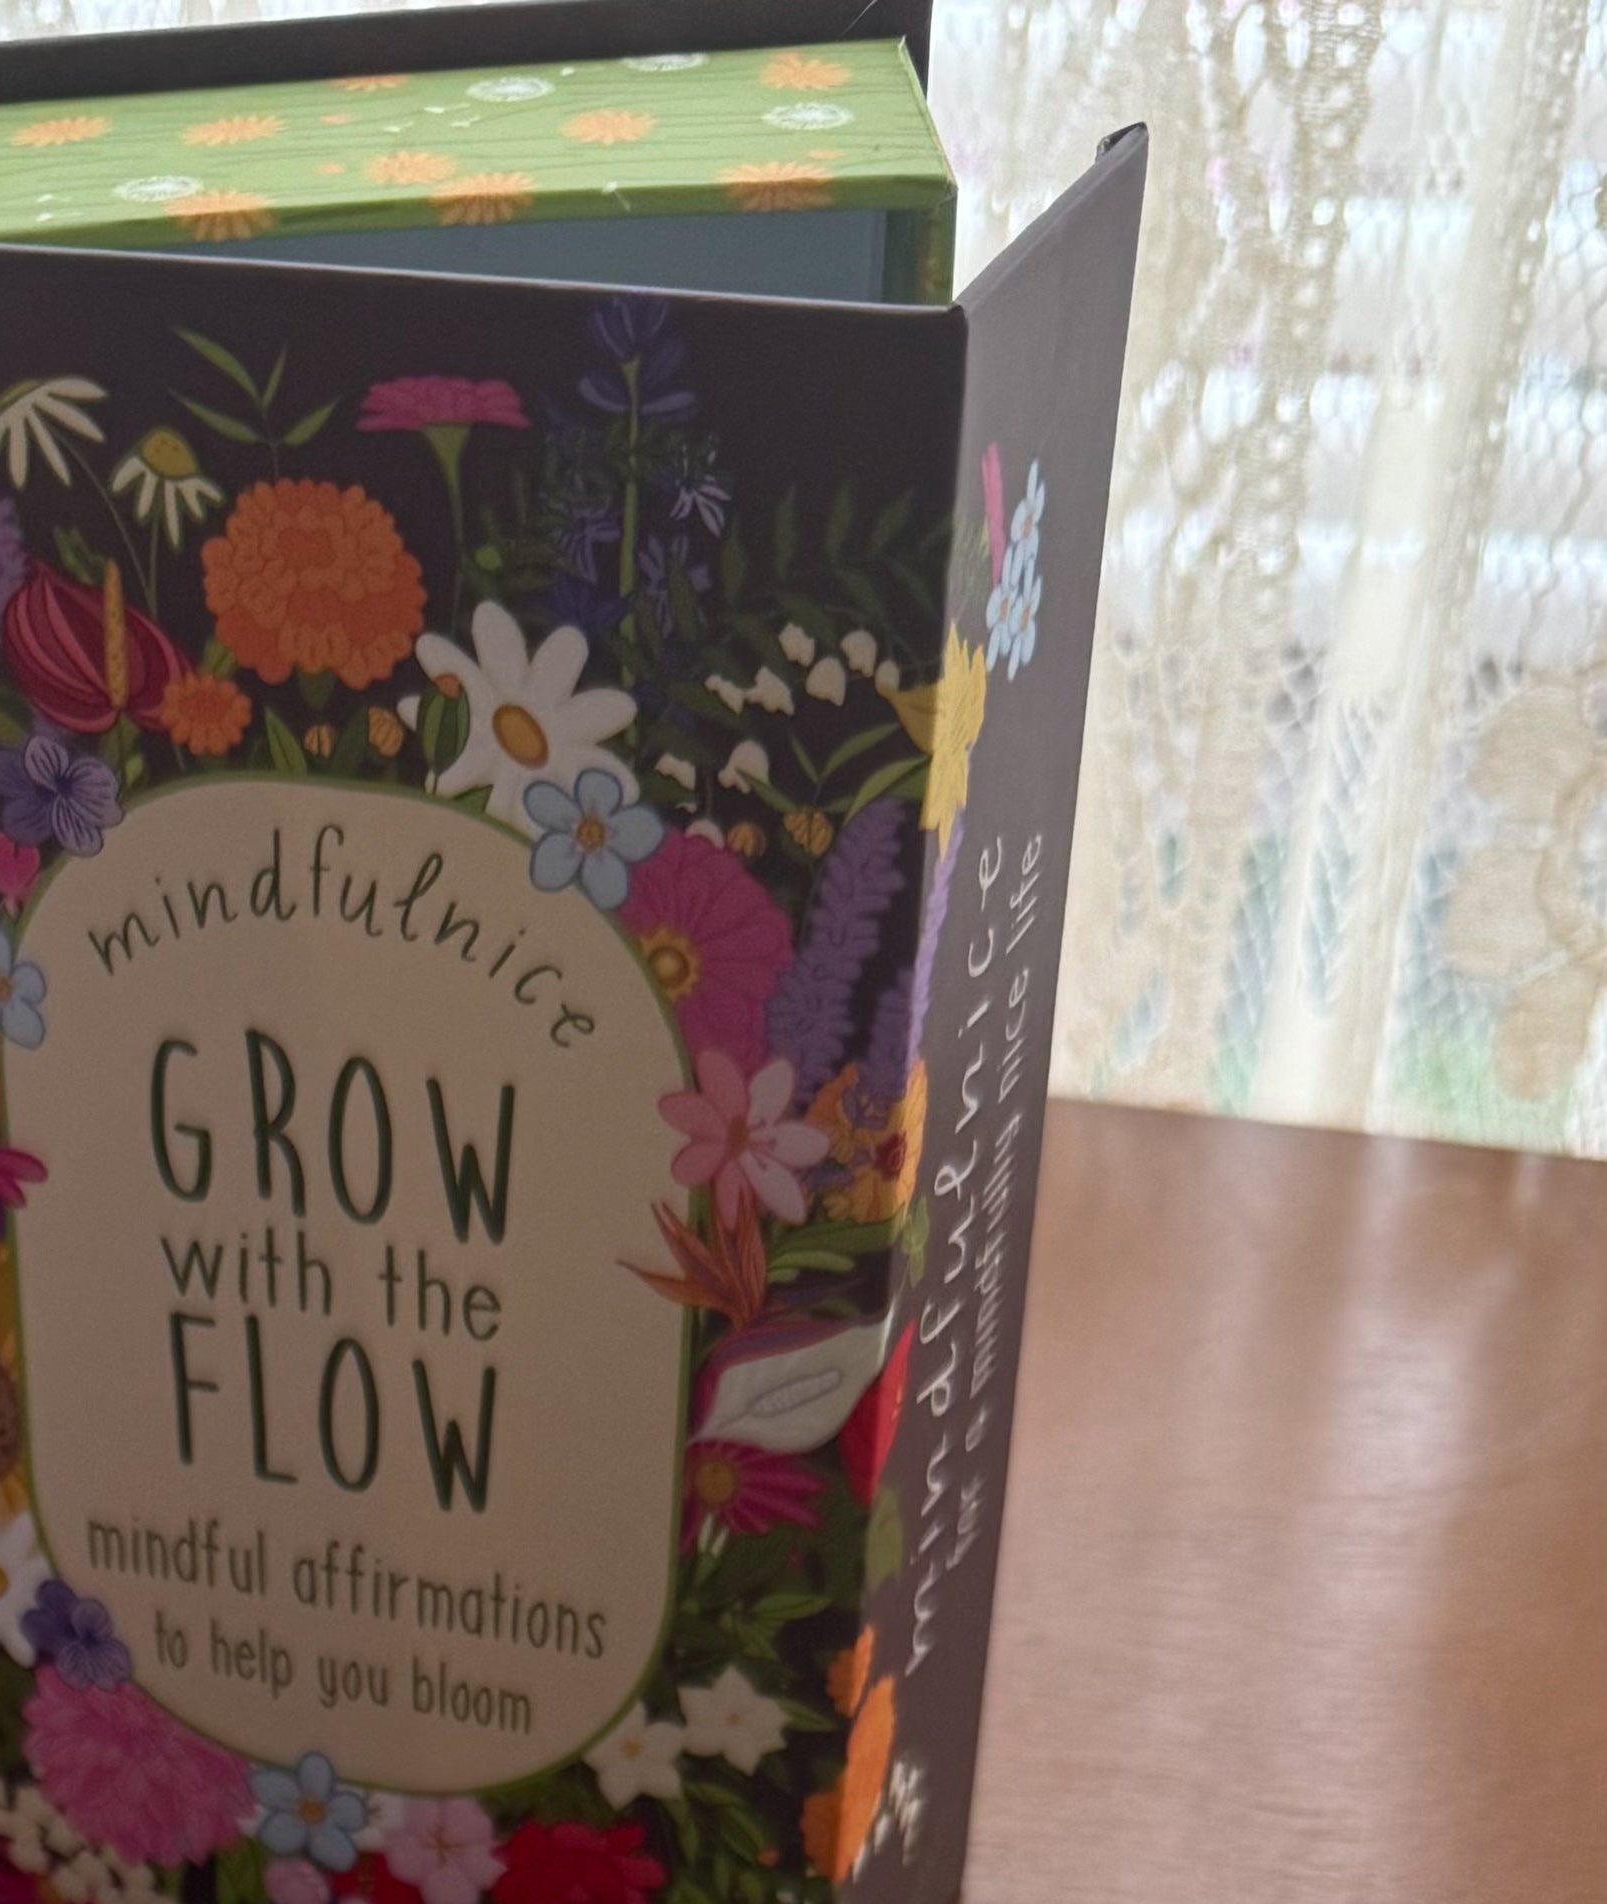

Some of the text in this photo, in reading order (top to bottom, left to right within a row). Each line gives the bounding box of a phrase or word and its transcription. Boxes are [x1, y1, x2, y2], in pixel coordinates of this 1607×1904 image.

[88, 824, 596, 1049] mindfulnice
[1006, 834, 1042, 954] life
[996, 968, 1029, 1103] nice
[149, 1027, 516, 1245] GROW
[160, 1227, 503, 1341] with the
[905, 834, 1002, 1677] mindfulnice
[169, 1310, 496, 1515] FLOW
[88, 1517, 606, 1659] mindful affirmations
[154, 1611, 533, 1735] to help you bloom
